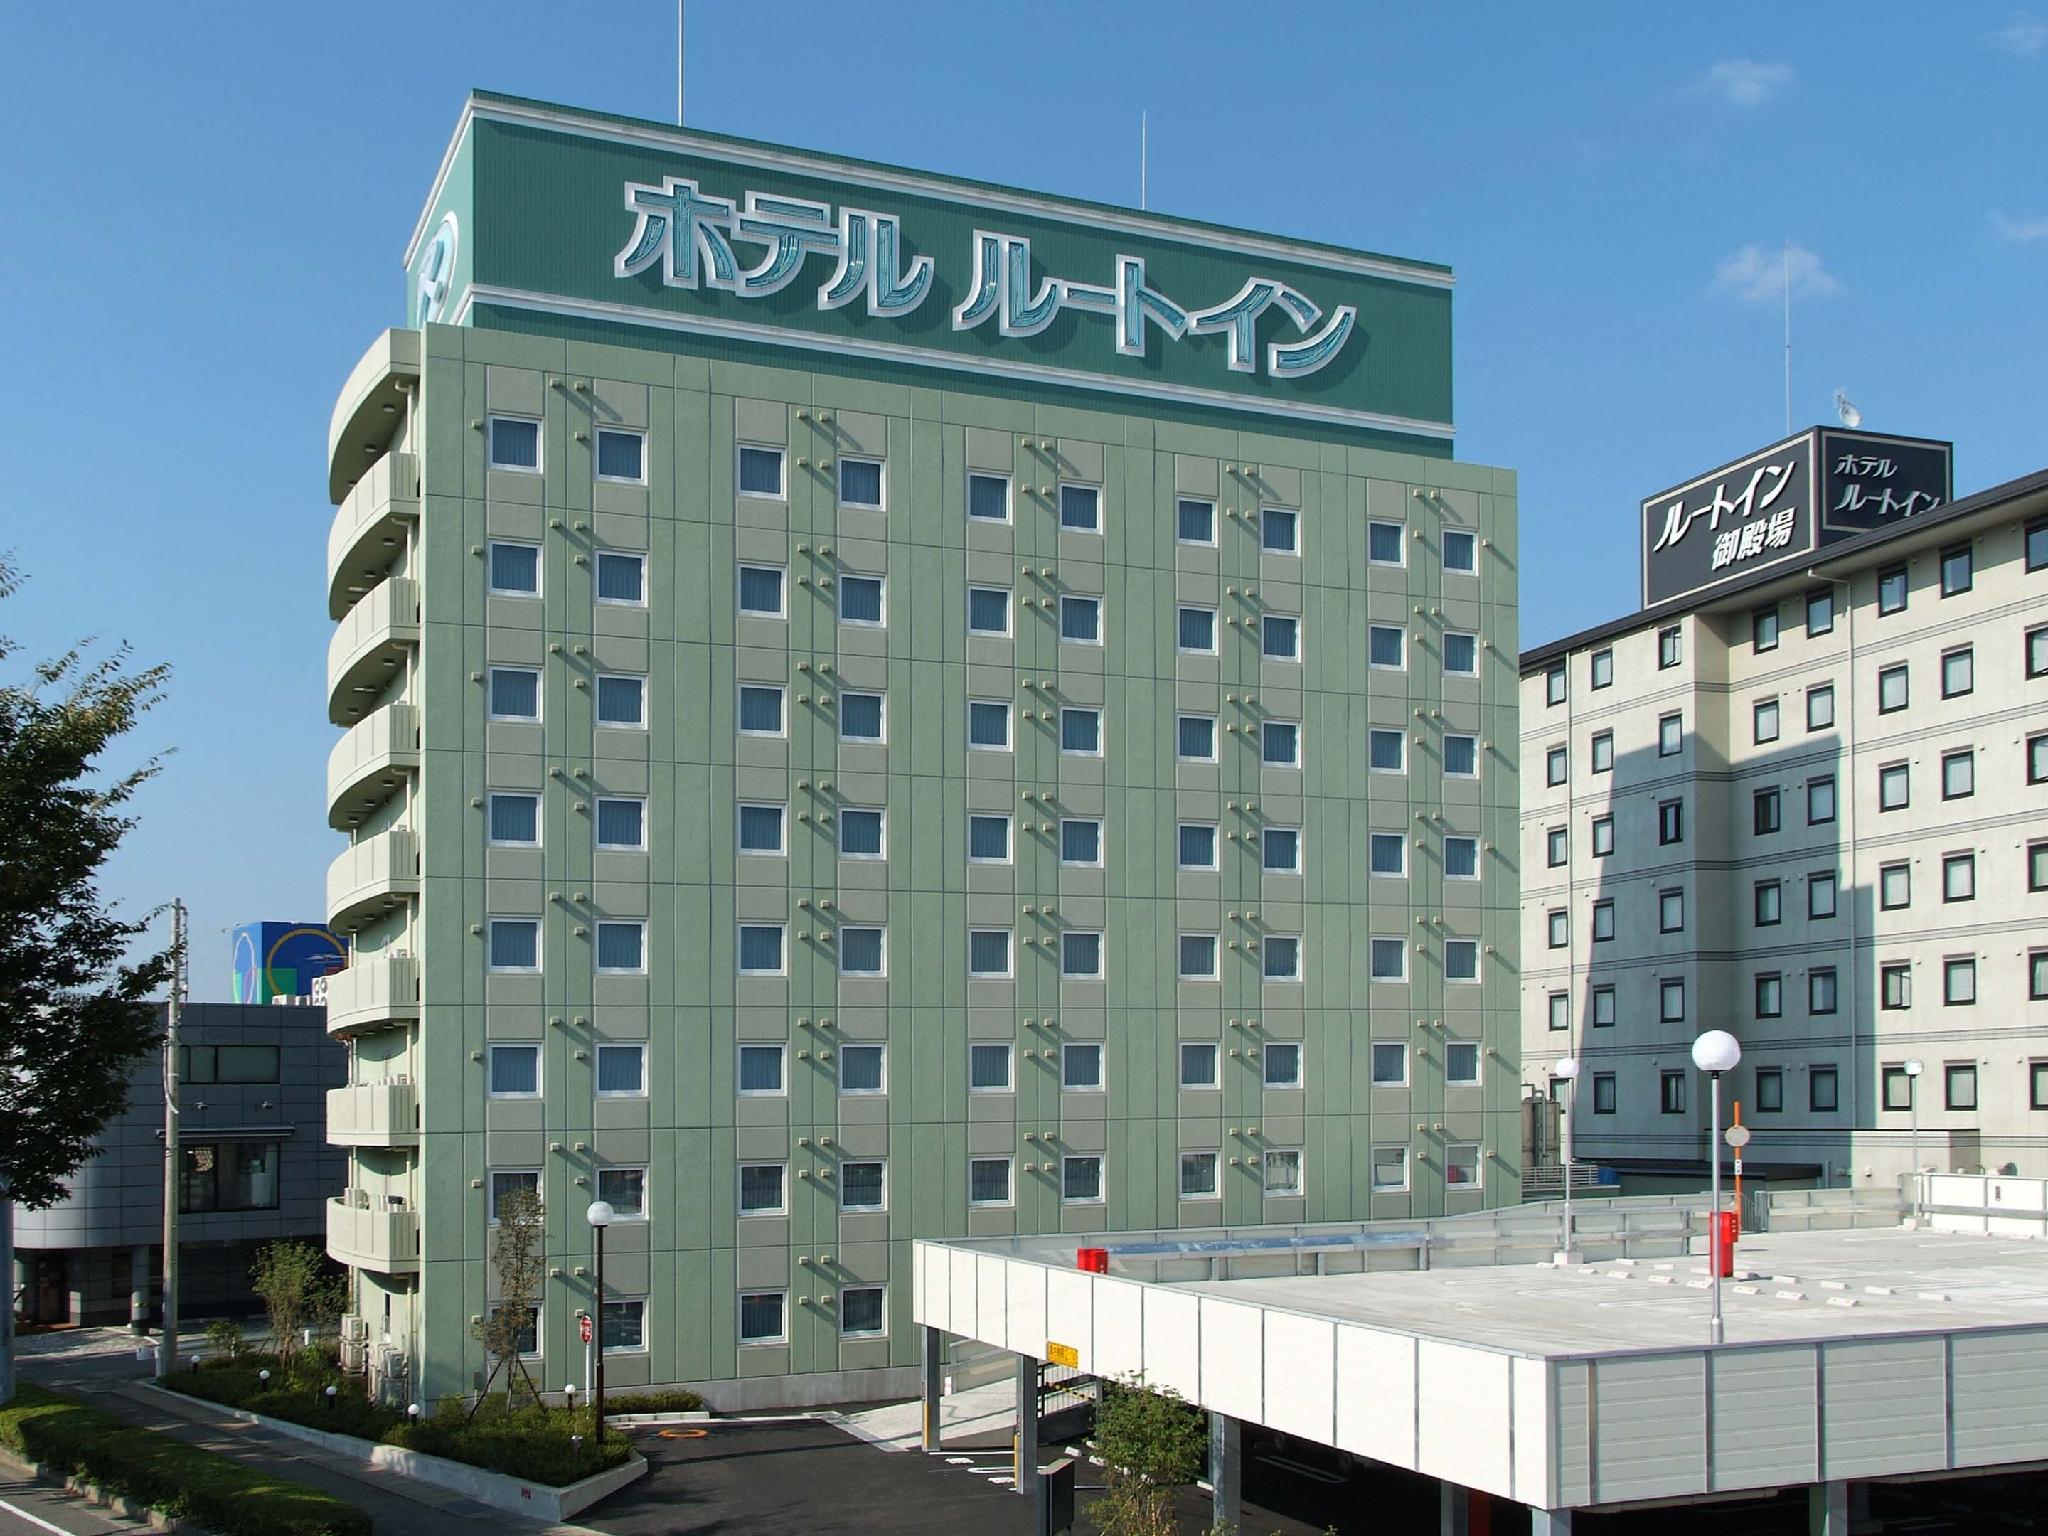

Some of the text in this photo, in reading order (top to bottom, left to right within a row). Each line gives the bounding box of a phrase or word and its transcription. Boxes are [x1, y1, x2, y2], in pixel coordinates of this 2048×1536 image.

[613, 175, 1357, 378] ホテル ルートイン
[1834, 454, 1898, 479] ホテル
[1653, 461, 1797, 552] ルートイン
[1712, 507, 1795, 571] 御殿場
